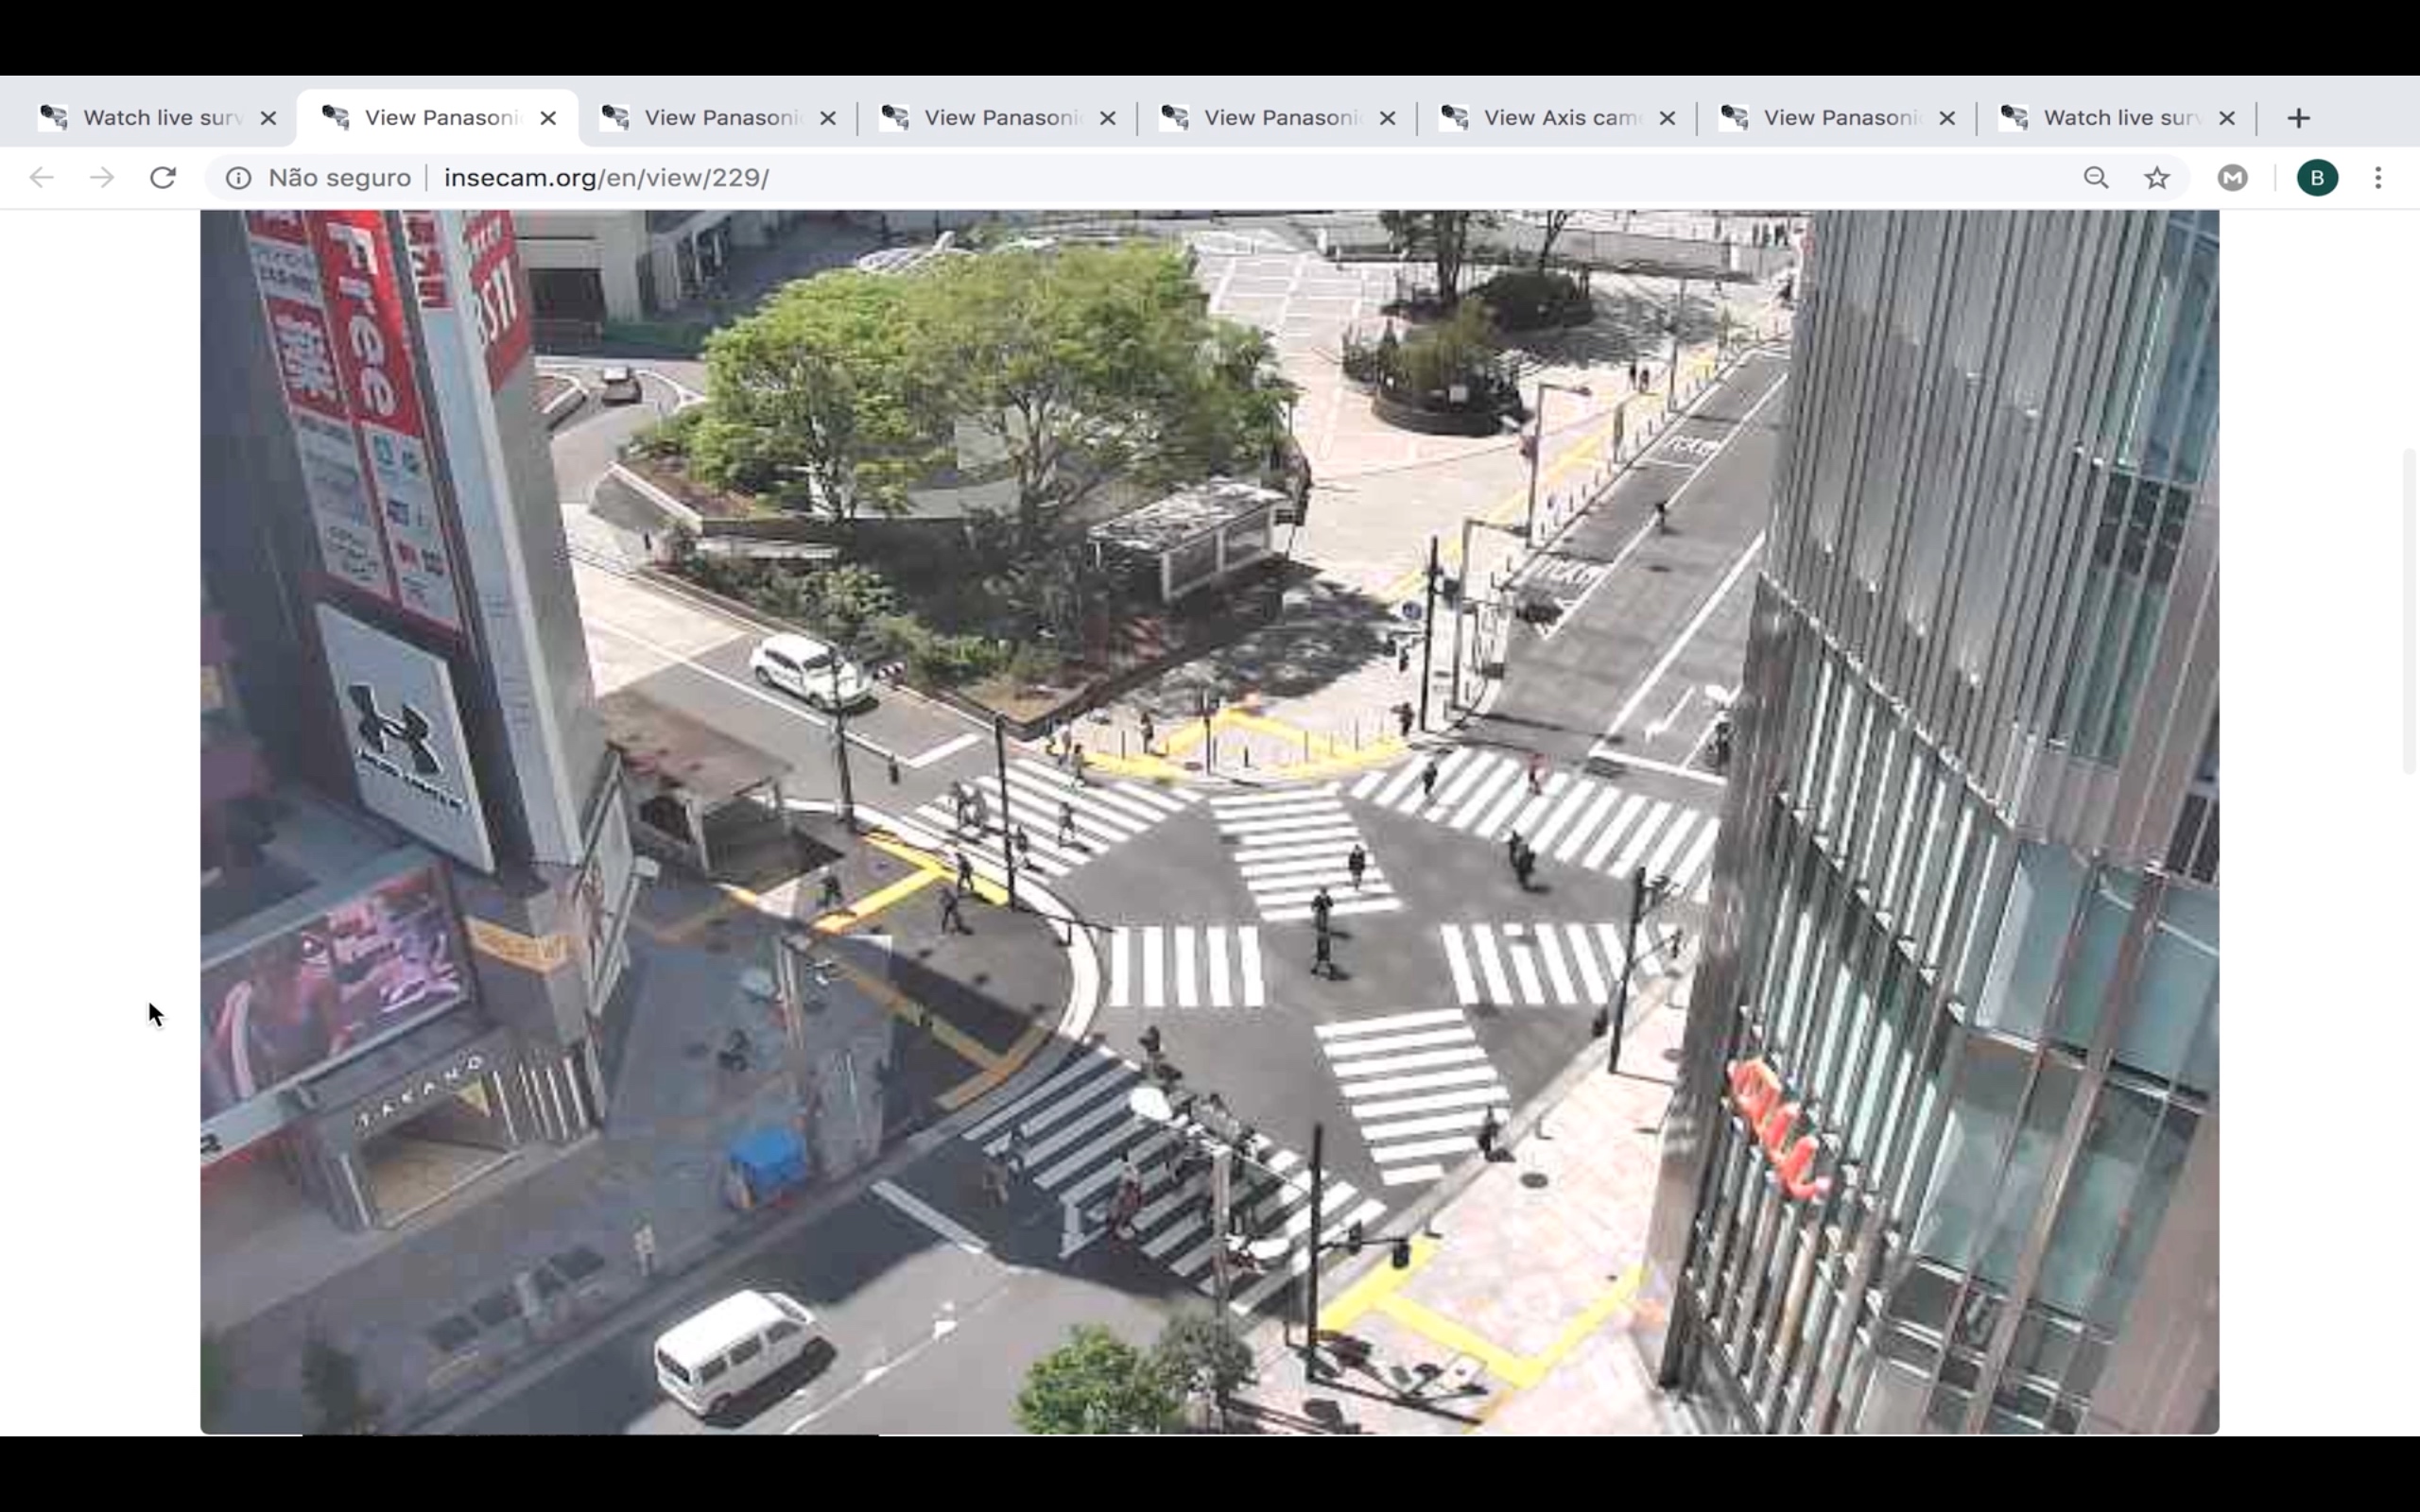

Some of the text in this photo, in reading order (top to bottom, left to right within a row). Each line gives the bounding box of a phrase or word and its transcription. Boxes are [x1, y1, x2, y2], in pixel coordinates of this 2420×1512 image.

[83, 109, 150, 126] Watch
[158, 109, 193, 126] live
[365, 109, 416, 126] View
[645, 109, 696, 126] View
[925, 109, 976, 126] View
[1204, 109, 1255, 126] View
[1484, 109, 1535, 126] View
[1543, 109, 1586, 126] Axis
[1764, 109, 1815, 126] View
[2044, 109, 2111, 126] Watch
[2118, 109, 2153, 126] live
[269, 167, 411, 192] Não seguro
[445, 167, 769, 192] insecam.org/en/view/229/
[2311, 170, 2325, 185] B
[326, 222, 395, 417] Free
